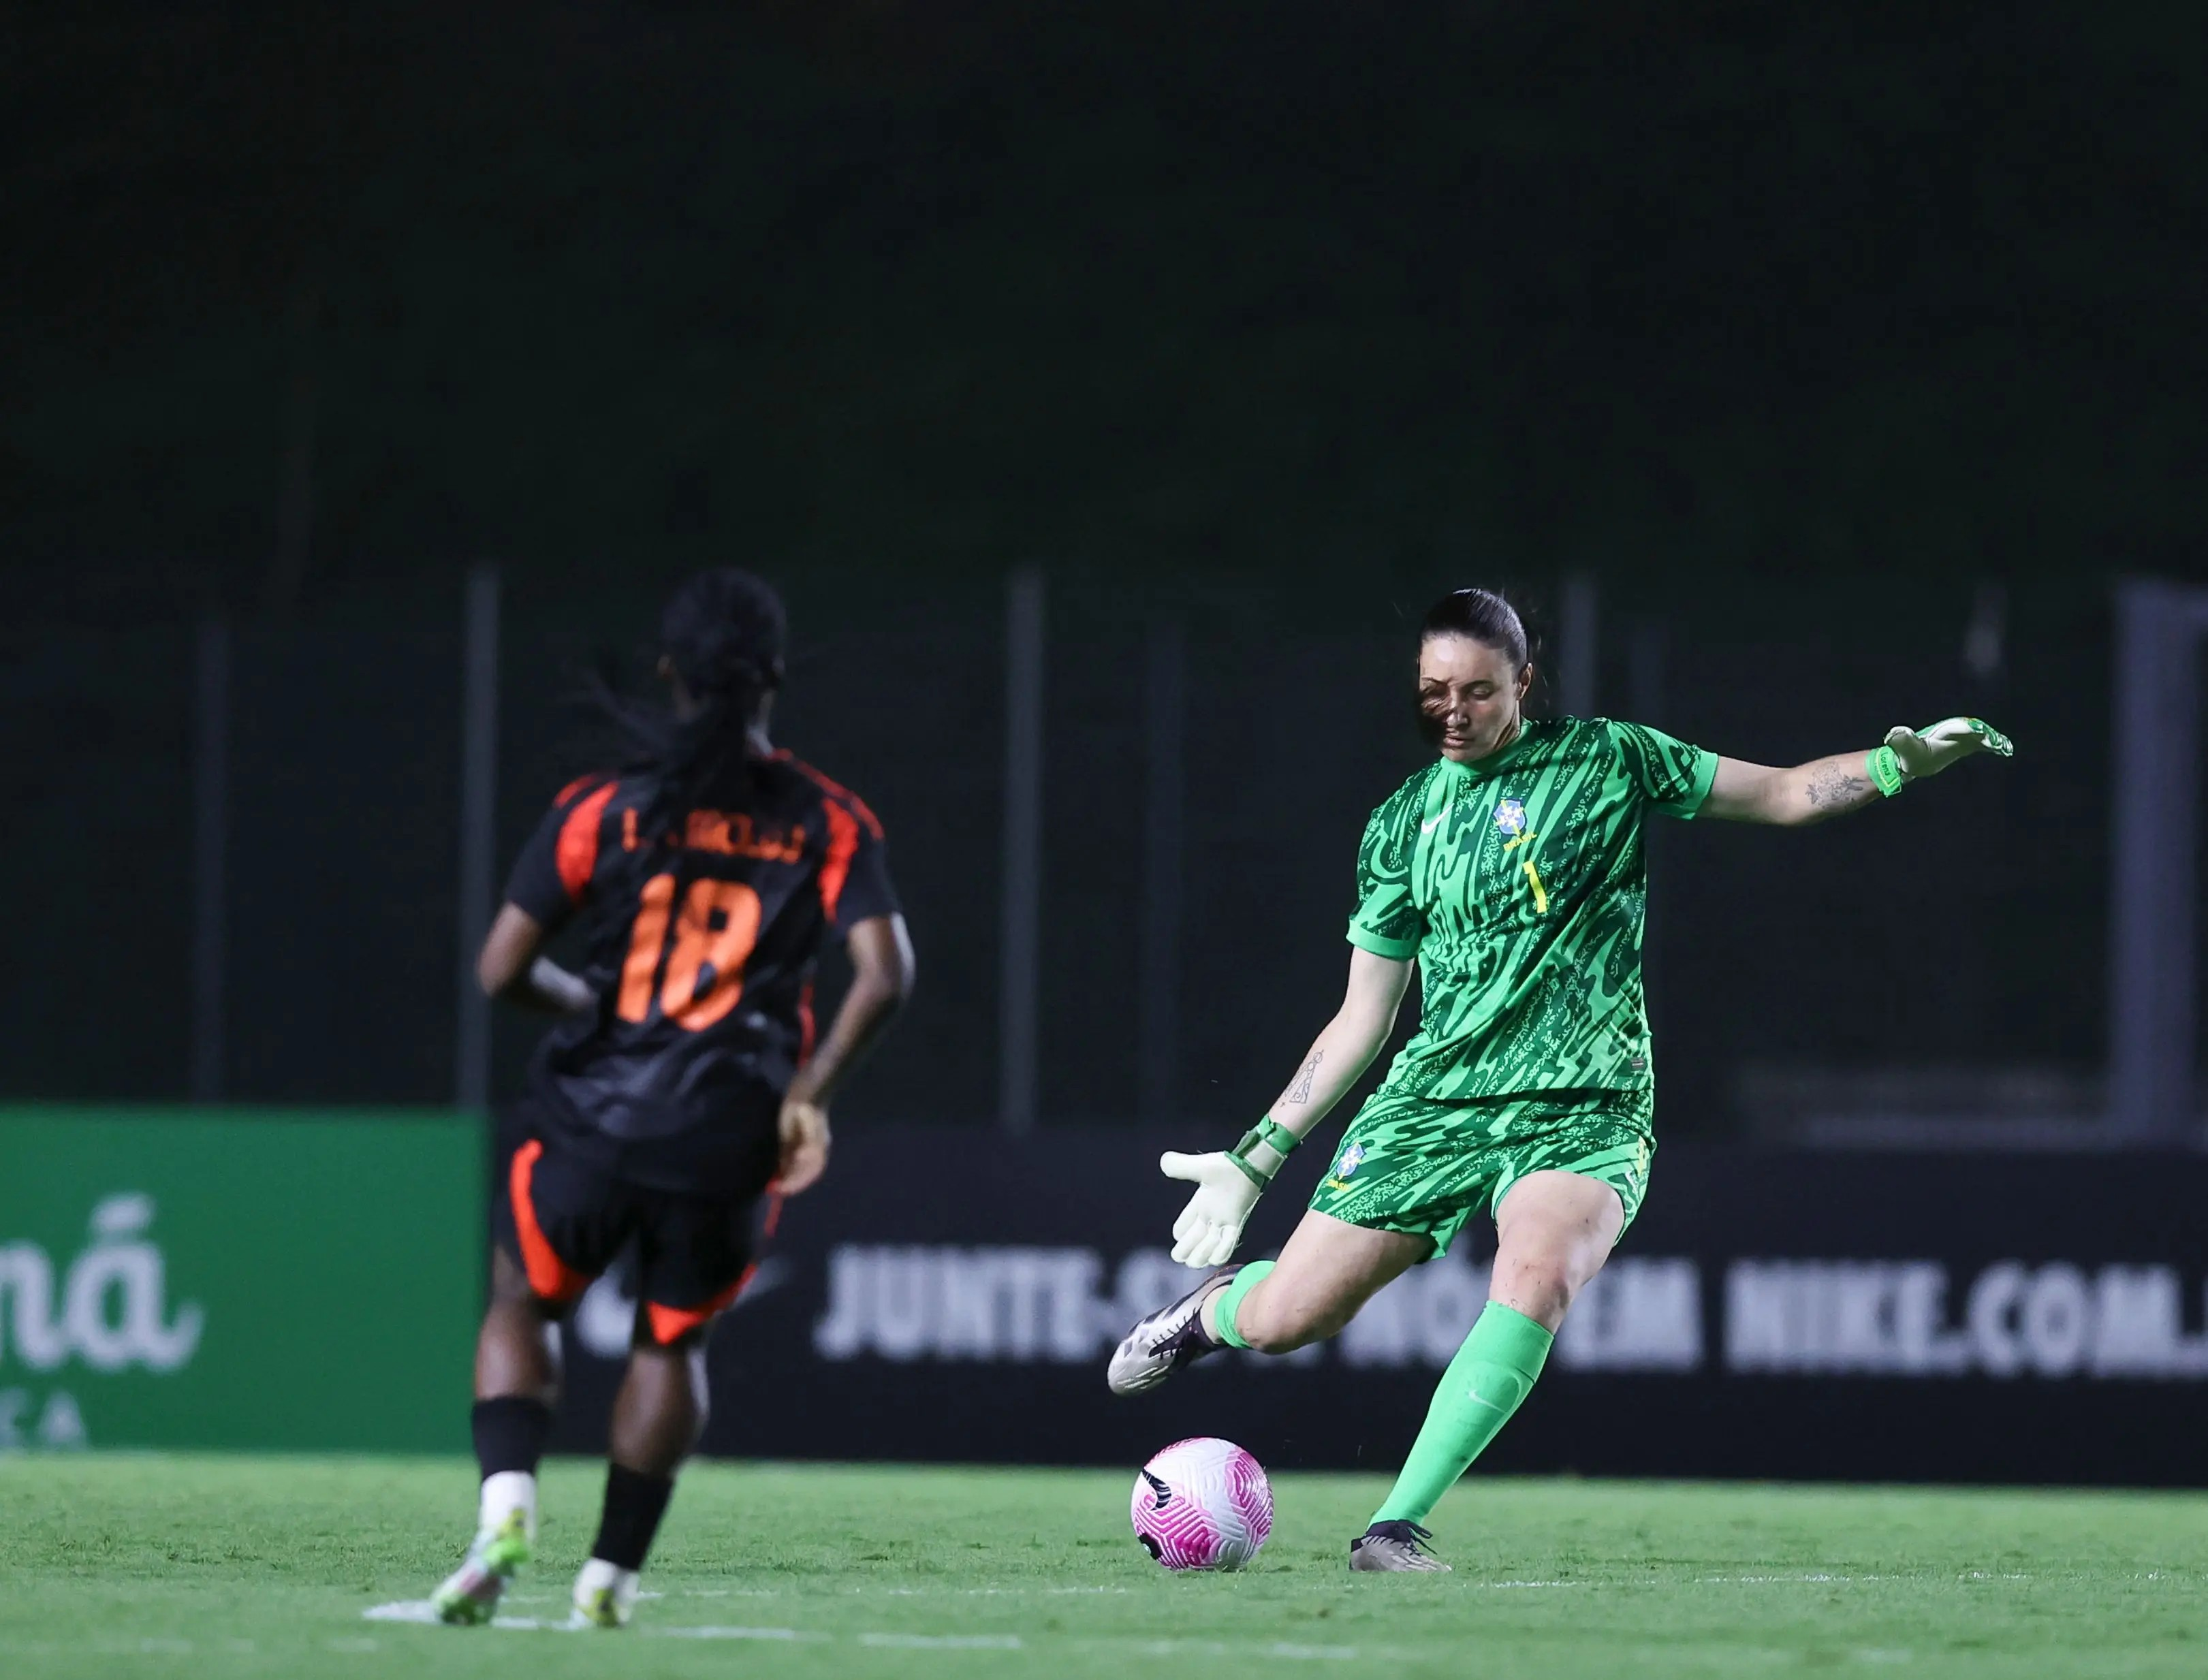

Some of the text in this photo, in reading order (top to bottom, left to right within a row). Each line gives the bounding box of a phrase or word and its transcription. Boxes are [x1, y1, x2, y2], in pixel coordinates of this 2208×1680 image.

[1503, 832, 1537, 851] BRASIL
[1523, 861, 1547, 913] 1
[617, 874, 761, 1032] 18
